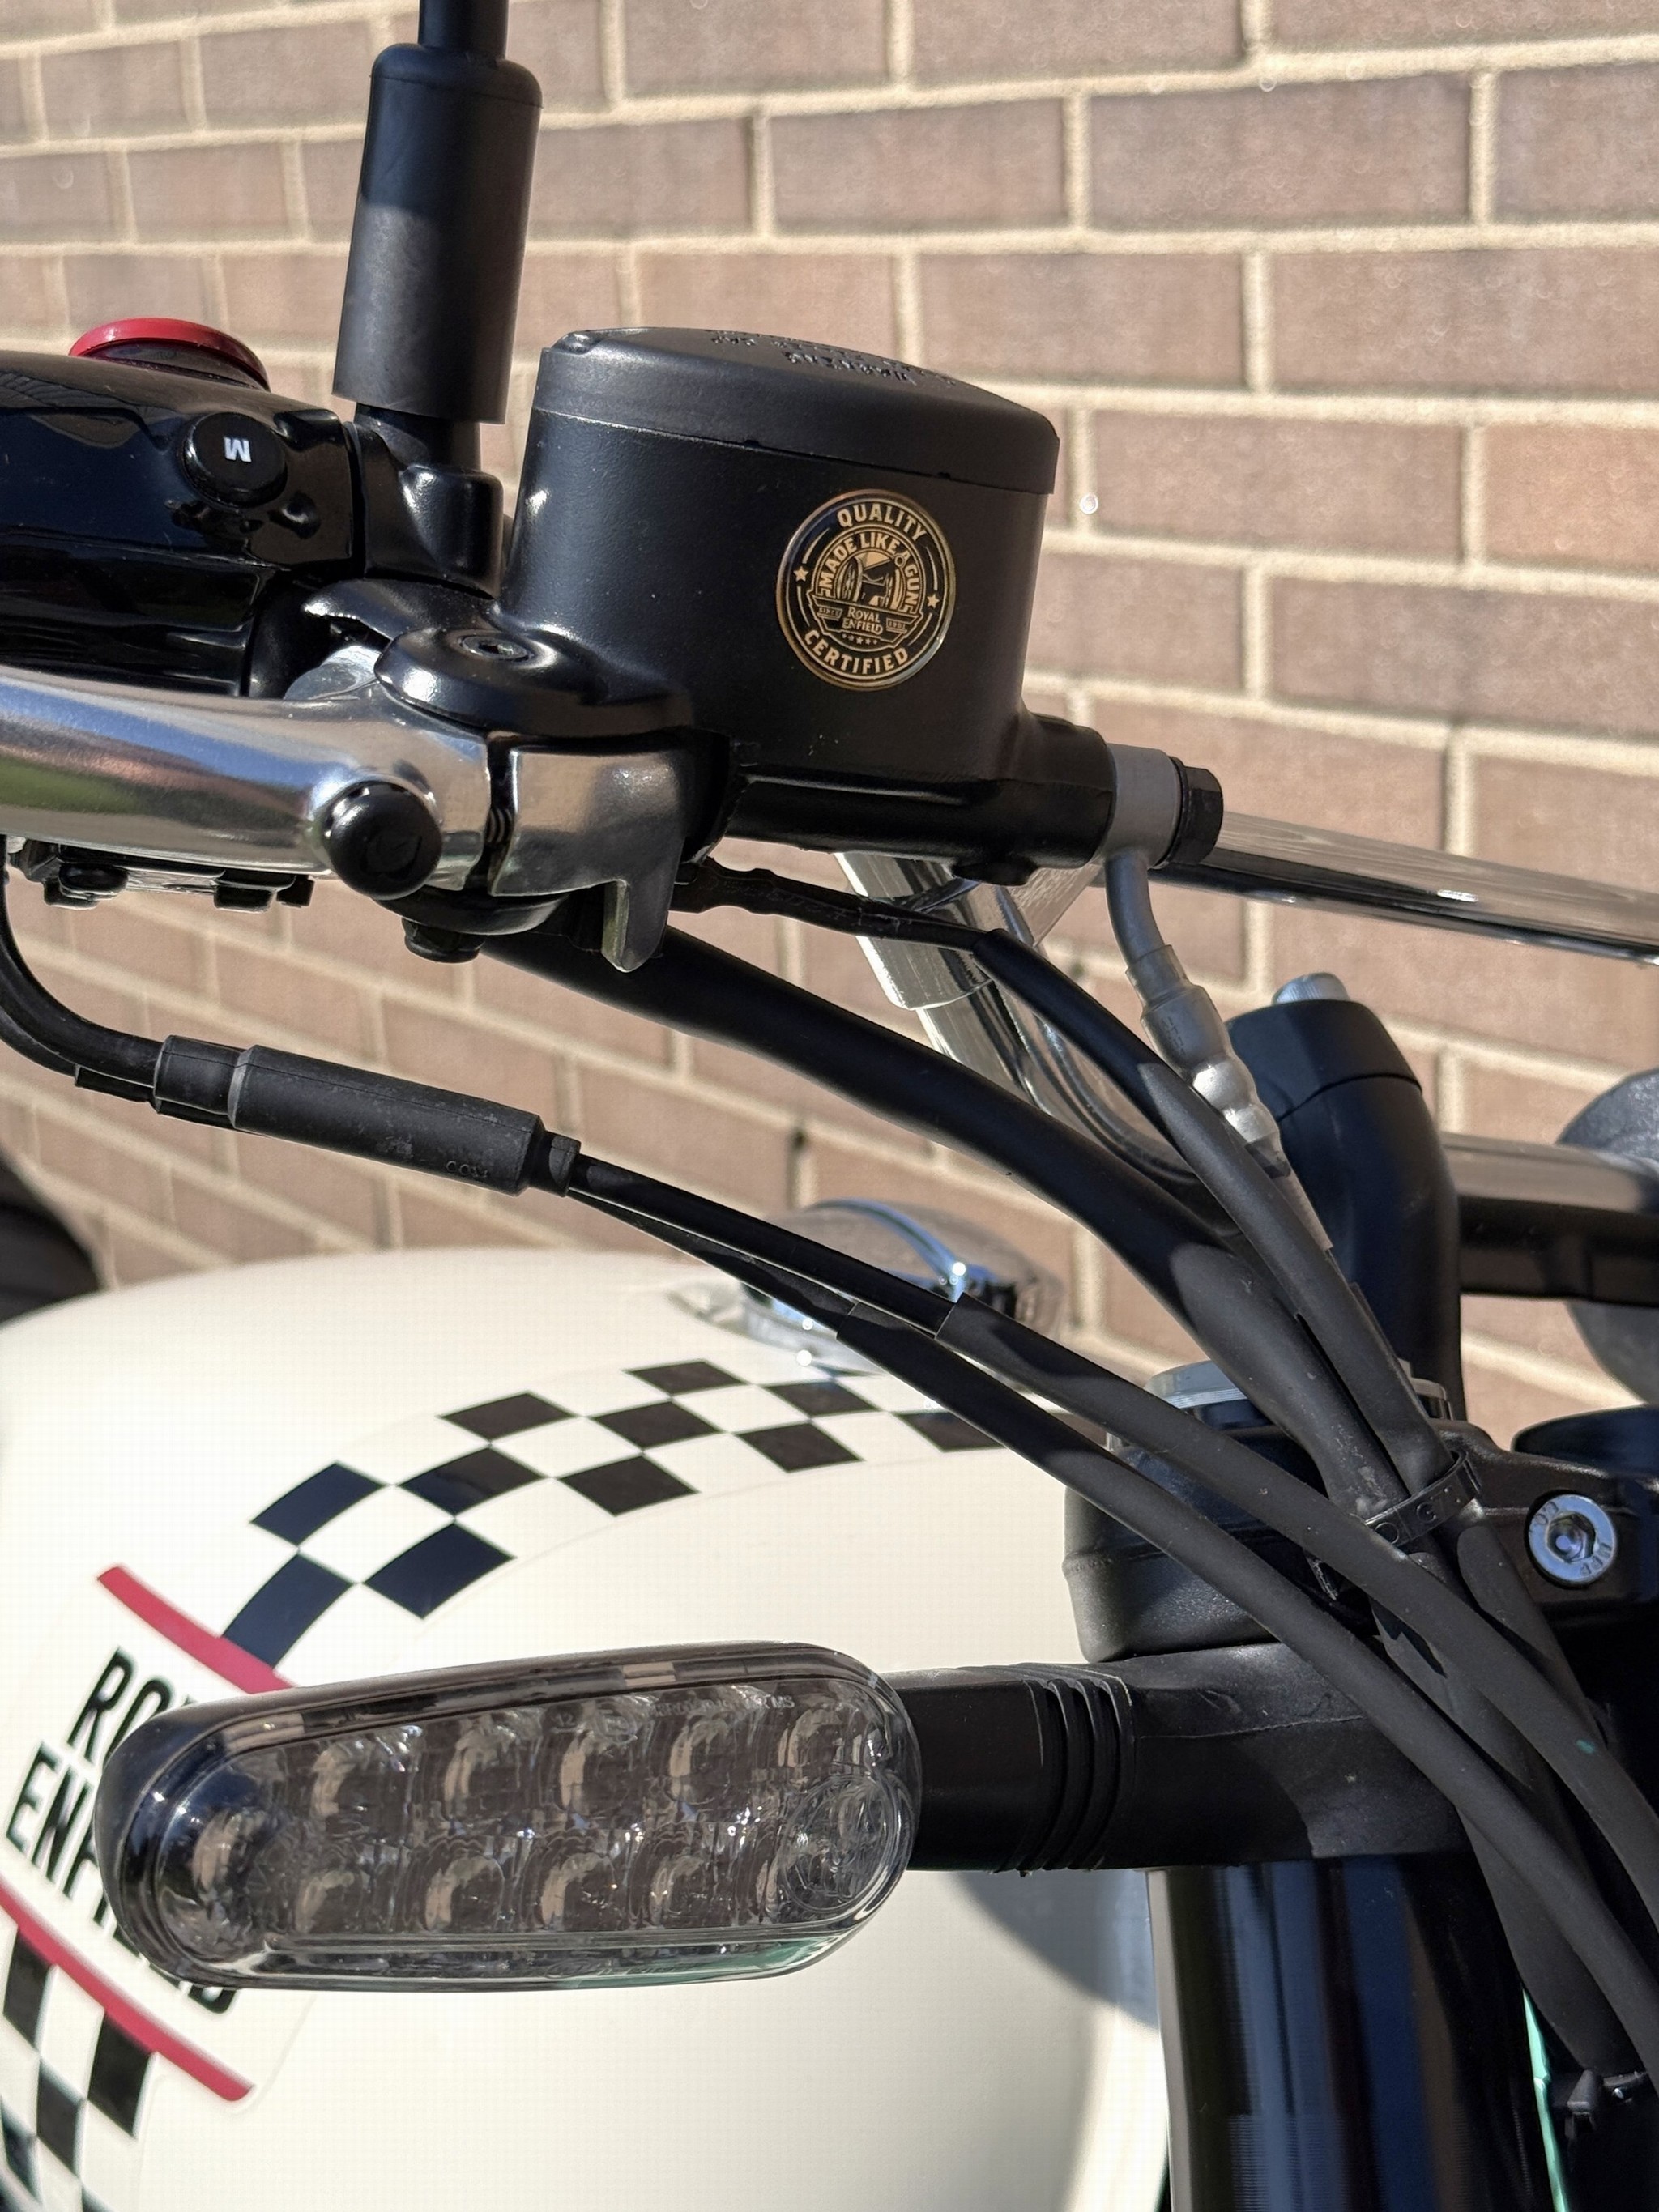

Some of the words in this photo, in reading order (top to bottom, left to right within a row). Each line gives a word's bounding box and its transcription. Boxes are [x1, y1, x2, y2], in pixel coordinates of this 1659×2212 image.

[837, 503, 928, 541] QUALITY
[818, 537, 858, 590] MADE
[859, 531, 901, 556] LIKE
[904, 564, 920, 606] GUN
[842, 618, 884, 636] ENFIELD
[847, 606, 881, 624] ROYAL
[804, 629, 909, 675] CERTIFIED
